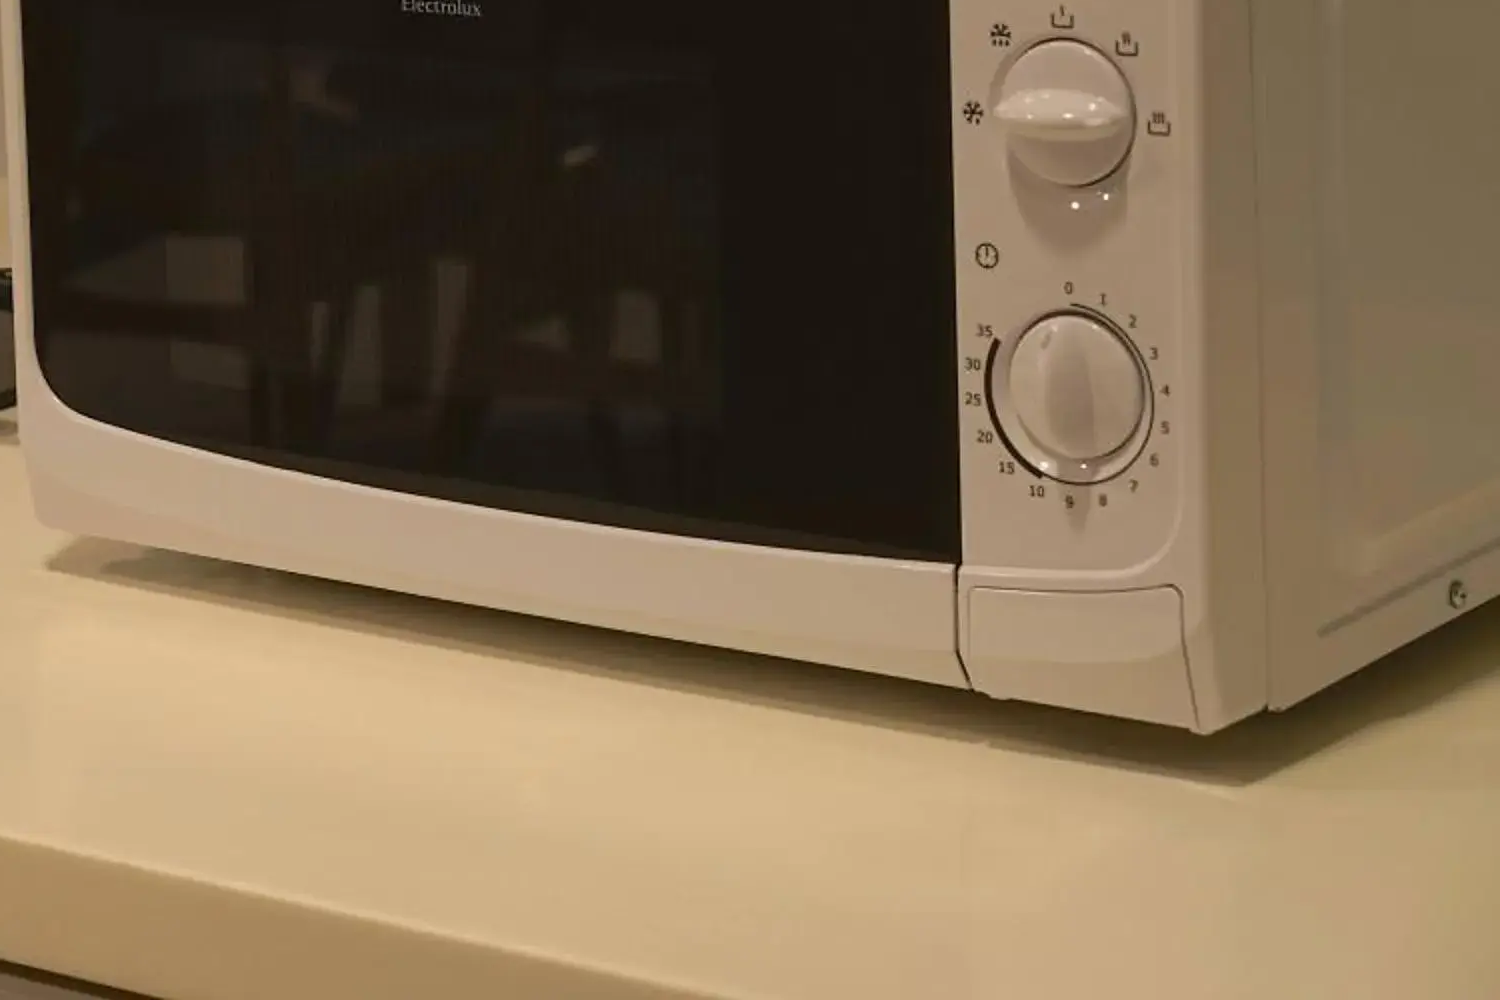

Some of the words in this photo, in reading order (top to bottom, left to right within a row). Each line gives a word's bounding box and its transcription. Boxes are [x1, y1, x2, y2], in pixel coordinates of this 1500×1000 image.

[1064, 281, 1073, 295] 0
[1099, 293, 1107, 306] 1
[1129, 314, 1137, 328] 2
[976, 325, 993, 338] 35
[1149, 347, 1159, 361] 3
[964, 358, 981, 371] 30
[1160, 384, 1170, 397] 4
[965, 393, 981, 406] 25
[977, 430, 993, 444] 20
[998, 461, 1015, 474] 15
[1029, 485, 1045, 498] 10
[1129, 480, 1138, 493] 7
